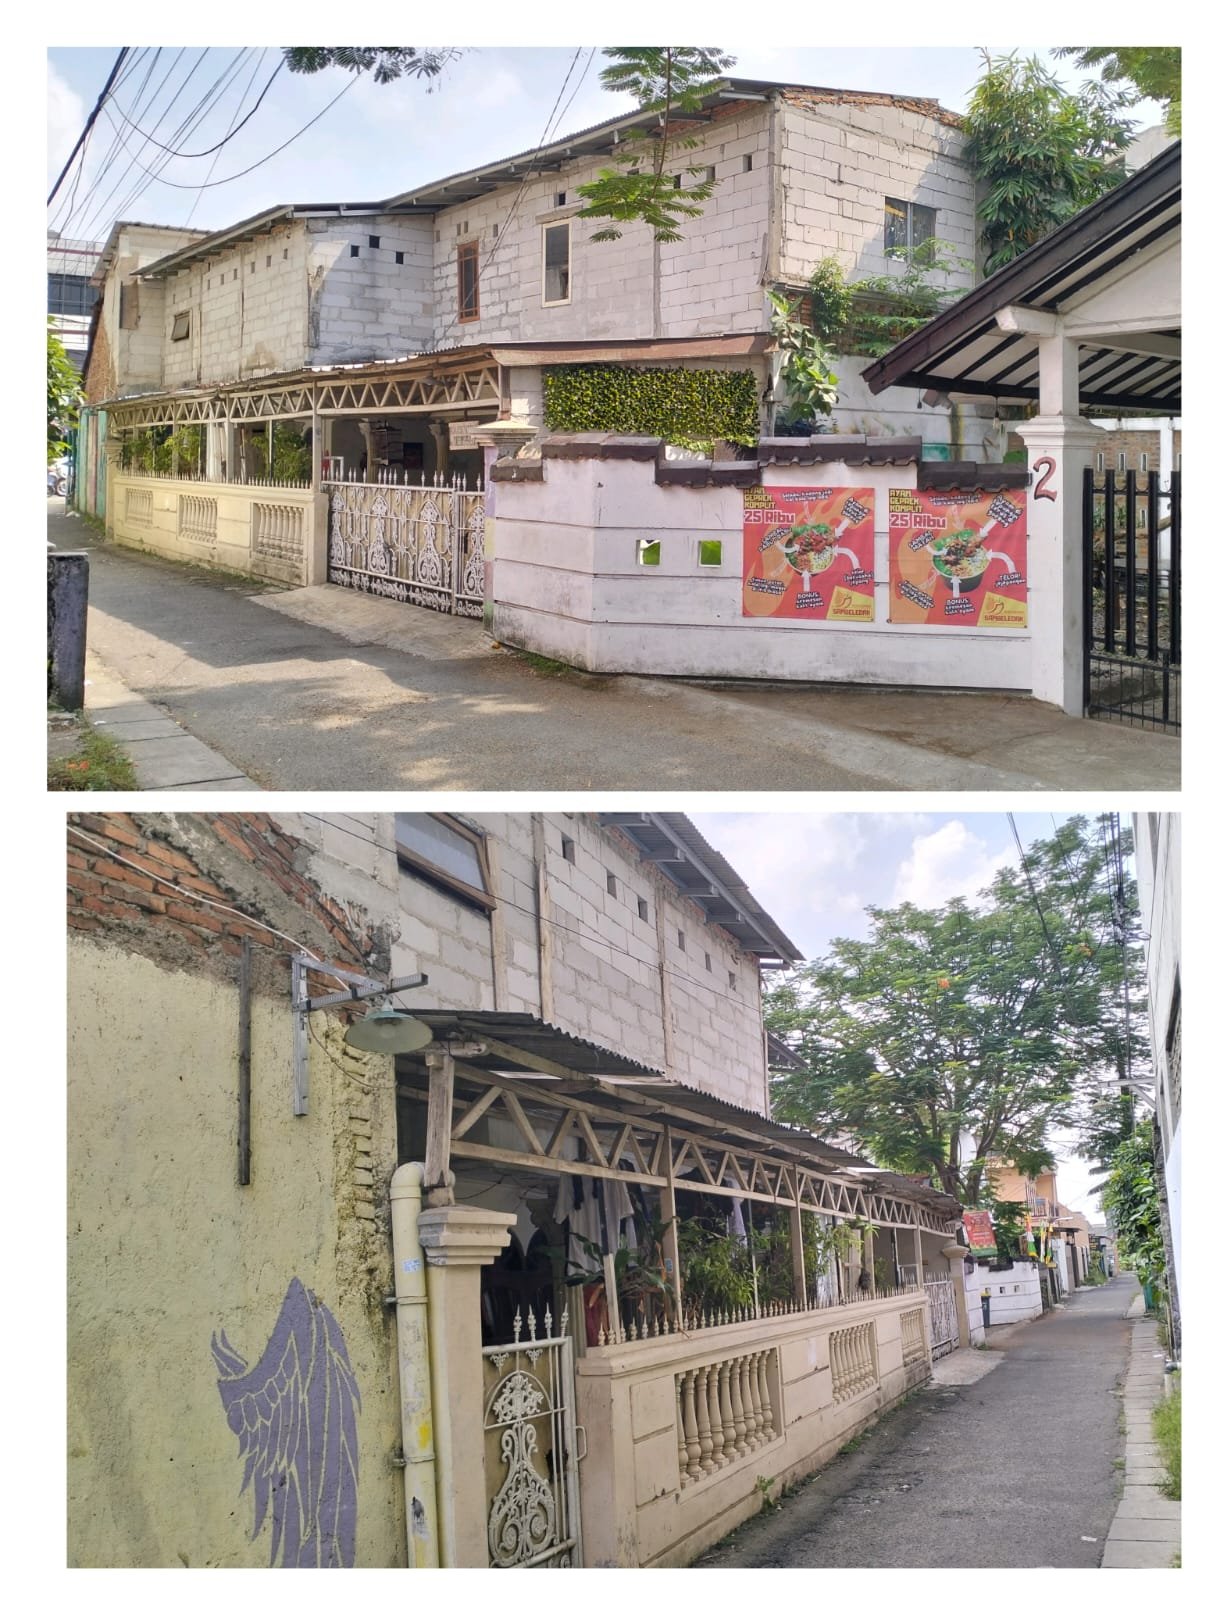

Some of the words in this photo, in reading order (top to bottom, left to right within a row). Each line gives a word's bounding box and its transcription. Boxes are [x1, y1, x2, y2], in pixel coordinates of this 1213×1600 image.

[1033, 456, 1057, 502] 2
[890, 489, 912, 497] AYAM
[890, 497, 920, 505] GEPREK
[890, 504, 923, 512] KOMPLIT
[744, 510, 762, 523] 25
[764, 510, 796, 524] Ribu
[890, 513, 910, 528] 25
[912, 514, 947, 530] Ribu
